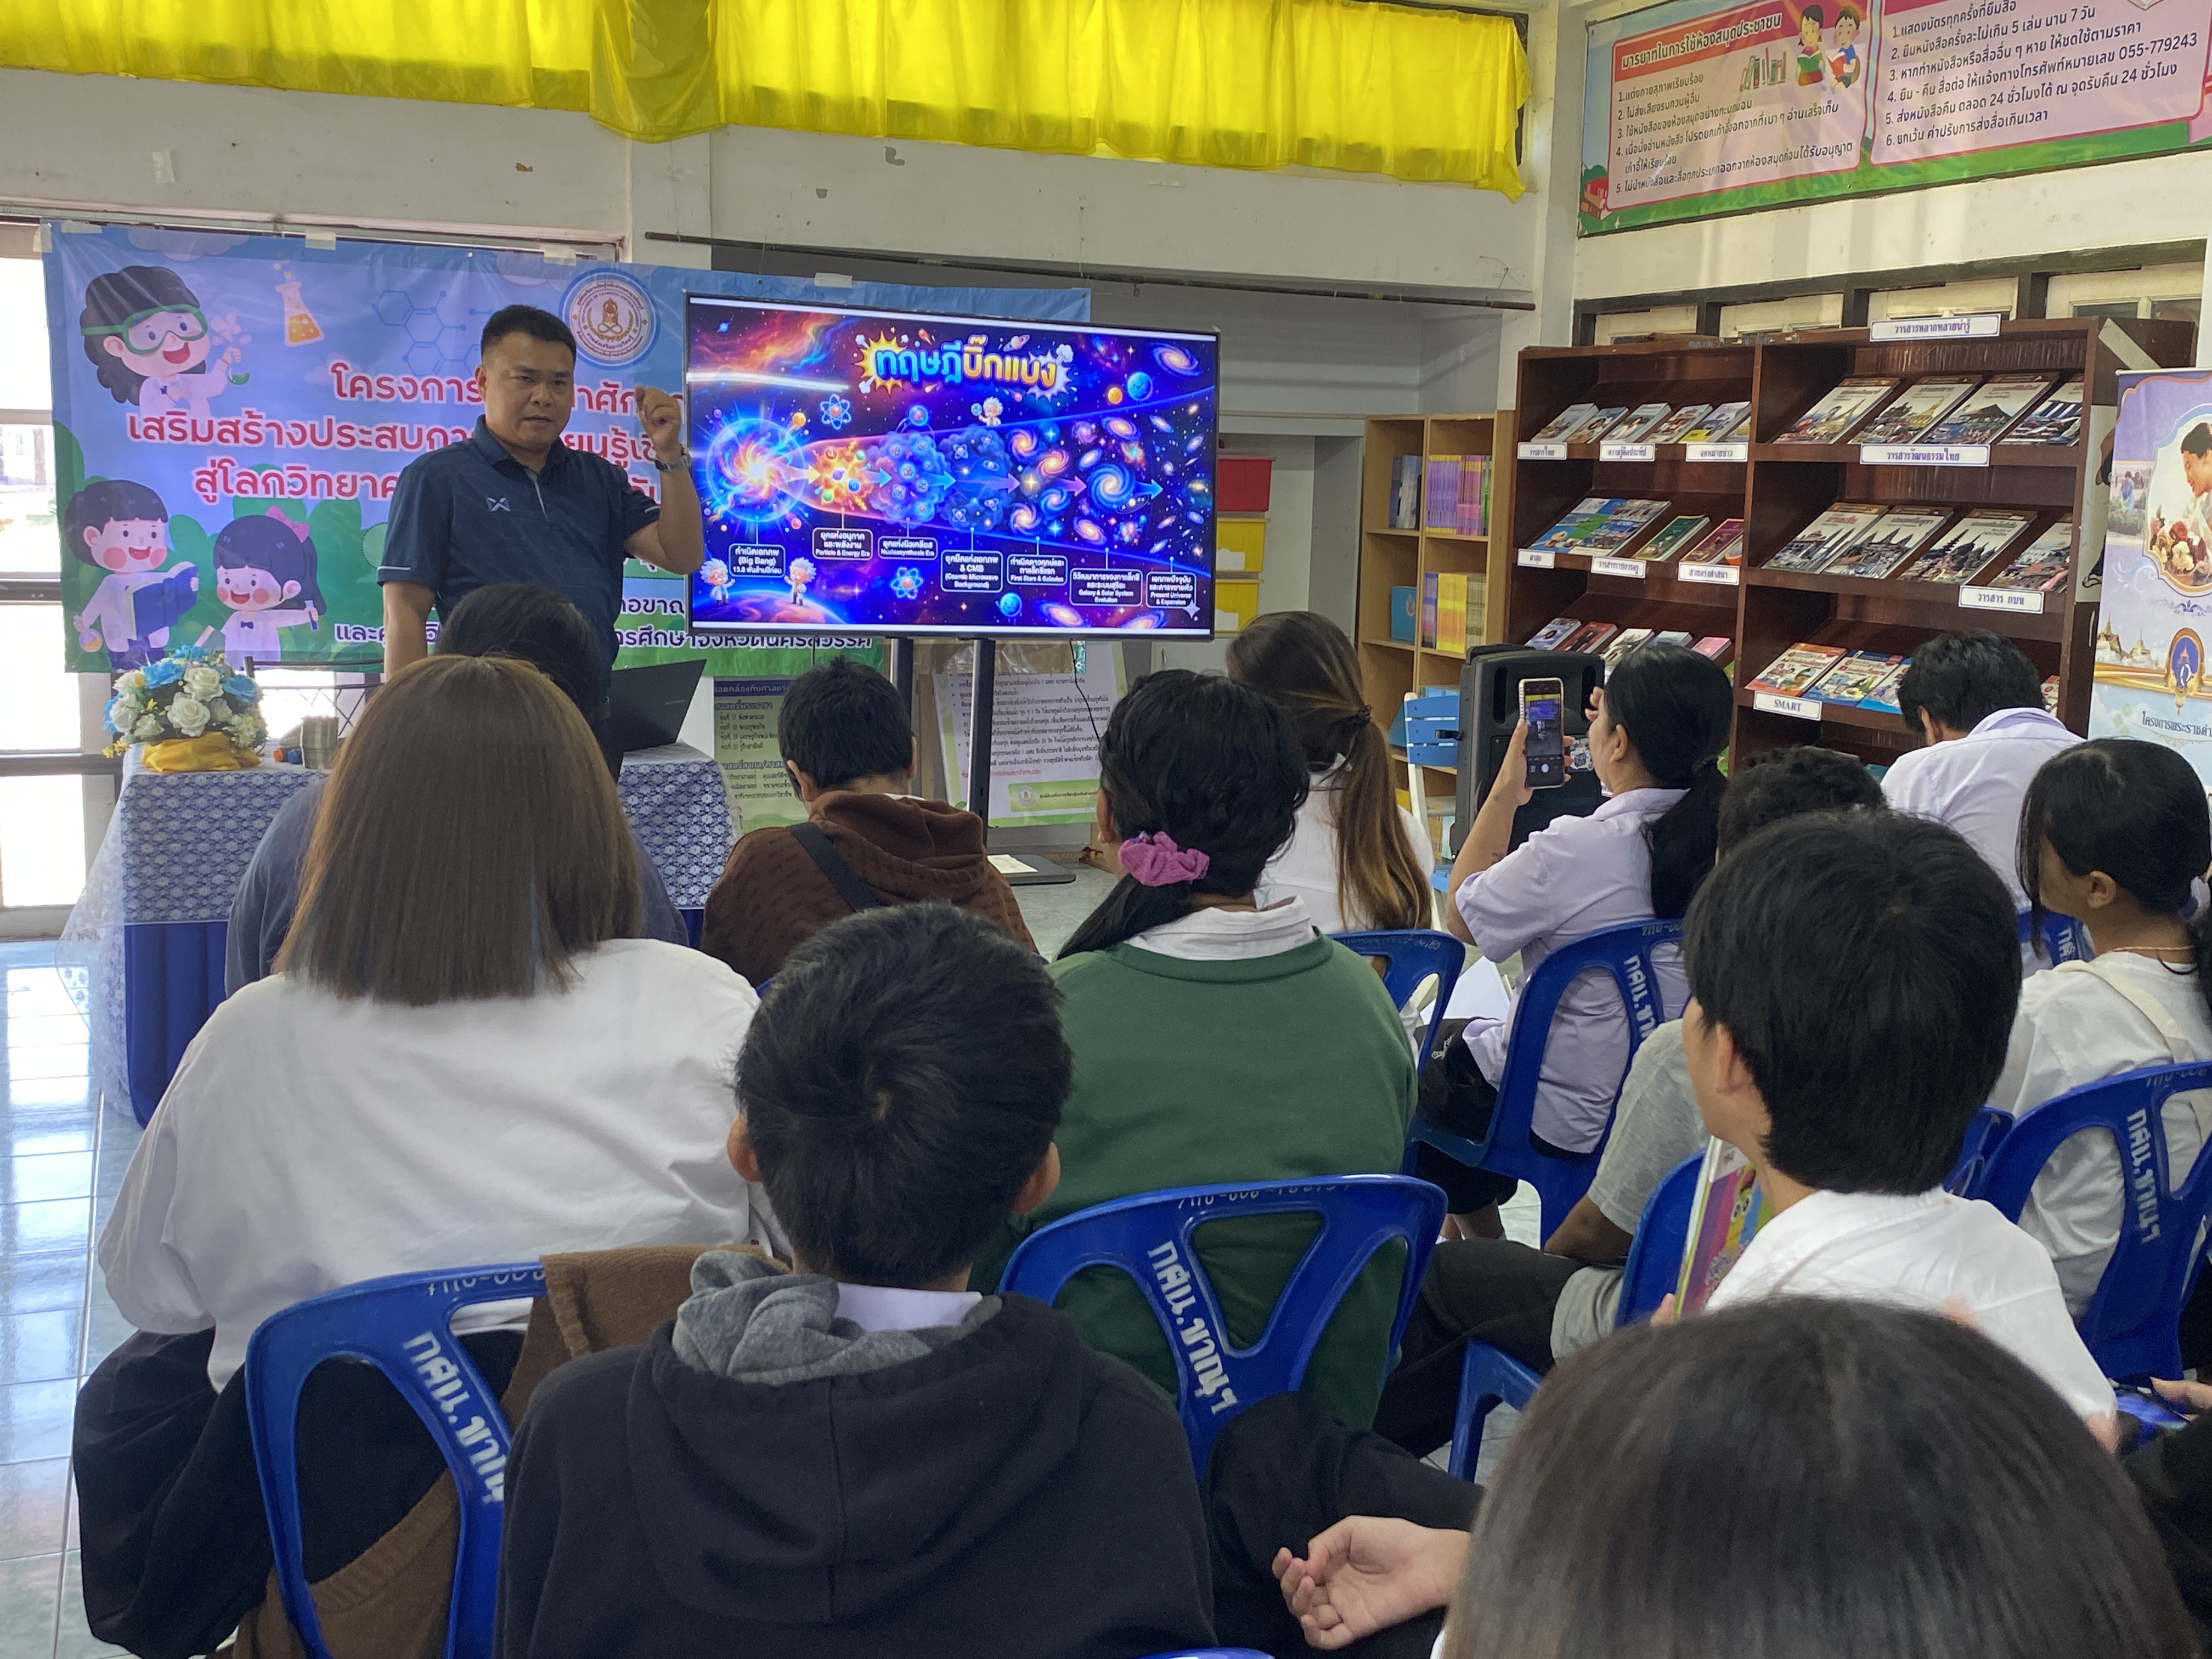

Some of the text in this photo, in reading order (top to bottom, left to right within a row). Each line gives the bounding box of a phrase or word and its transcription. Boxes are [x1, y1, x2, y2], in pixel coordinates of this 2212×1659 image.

[1903, 21, 2008, 58] ยืมหนังสือครั้งละไม่เกิน
[2012, 21, 2019, 33] 5
[2022, 16, 2042, 31] เล่ม
[2045, 14, 2068, 28] นาน
[2070, 9, 2078, 21] 7
[2080, 4, 2095, 19] วัน
[1901, 42, 2011, 81] หากทำหนังสือหรือสื่ออื่น
[2025, 40, 2047, 54] หาย
[2050, 22, 2142, 50] ให้ชดใช้ตามราคา
[1899, 84, 1914, 101] ยืม
[1922, 80, 1936, 98] คืน
[1938, 74, 1964, 95] สื่อต่อ
[1967, 51, 2115, 88] ให้แจ้งทางโทรศัพท์หมายเลข
[2119, 32, 2197, 61] 055-779243
[1896, 95, 1956, 123] ส่งหนังสือคืน
[1959, 97, 1987, 111] ตลอด
[1989, 93, 2004, 106] 24
[2007, 83, 2053, 104] ชั่วโมงได้
[2056, 83, 2068, 95] ณ
[2071, 72, 2118, 98] จุดรับคืน
[2121, 70, 2137, 84] 24
[2141, 61, 2177, 81] ชั่วโมง
[1897, 127, 1925, 145] ยกเว้น
[1927, 110, 2048, 139] ค่าปรับการส่งสื่อเกินเวลา
[1894, 318, 1972, 334] วารสารหลากหลายน่ารู้
[876, 334, 1058, 386] ทฤษฎีบิ๊กแบง
[1887, 448, 1960, 461] วารสารวัฒนธรรมไทย
[738, 556, 776, 566] (Big Bang)
[960, 563, 984, 572] & CMB
[1978, 593, 2004, 603] วารสาร
[1773, 699, 1802, 713] SMART
